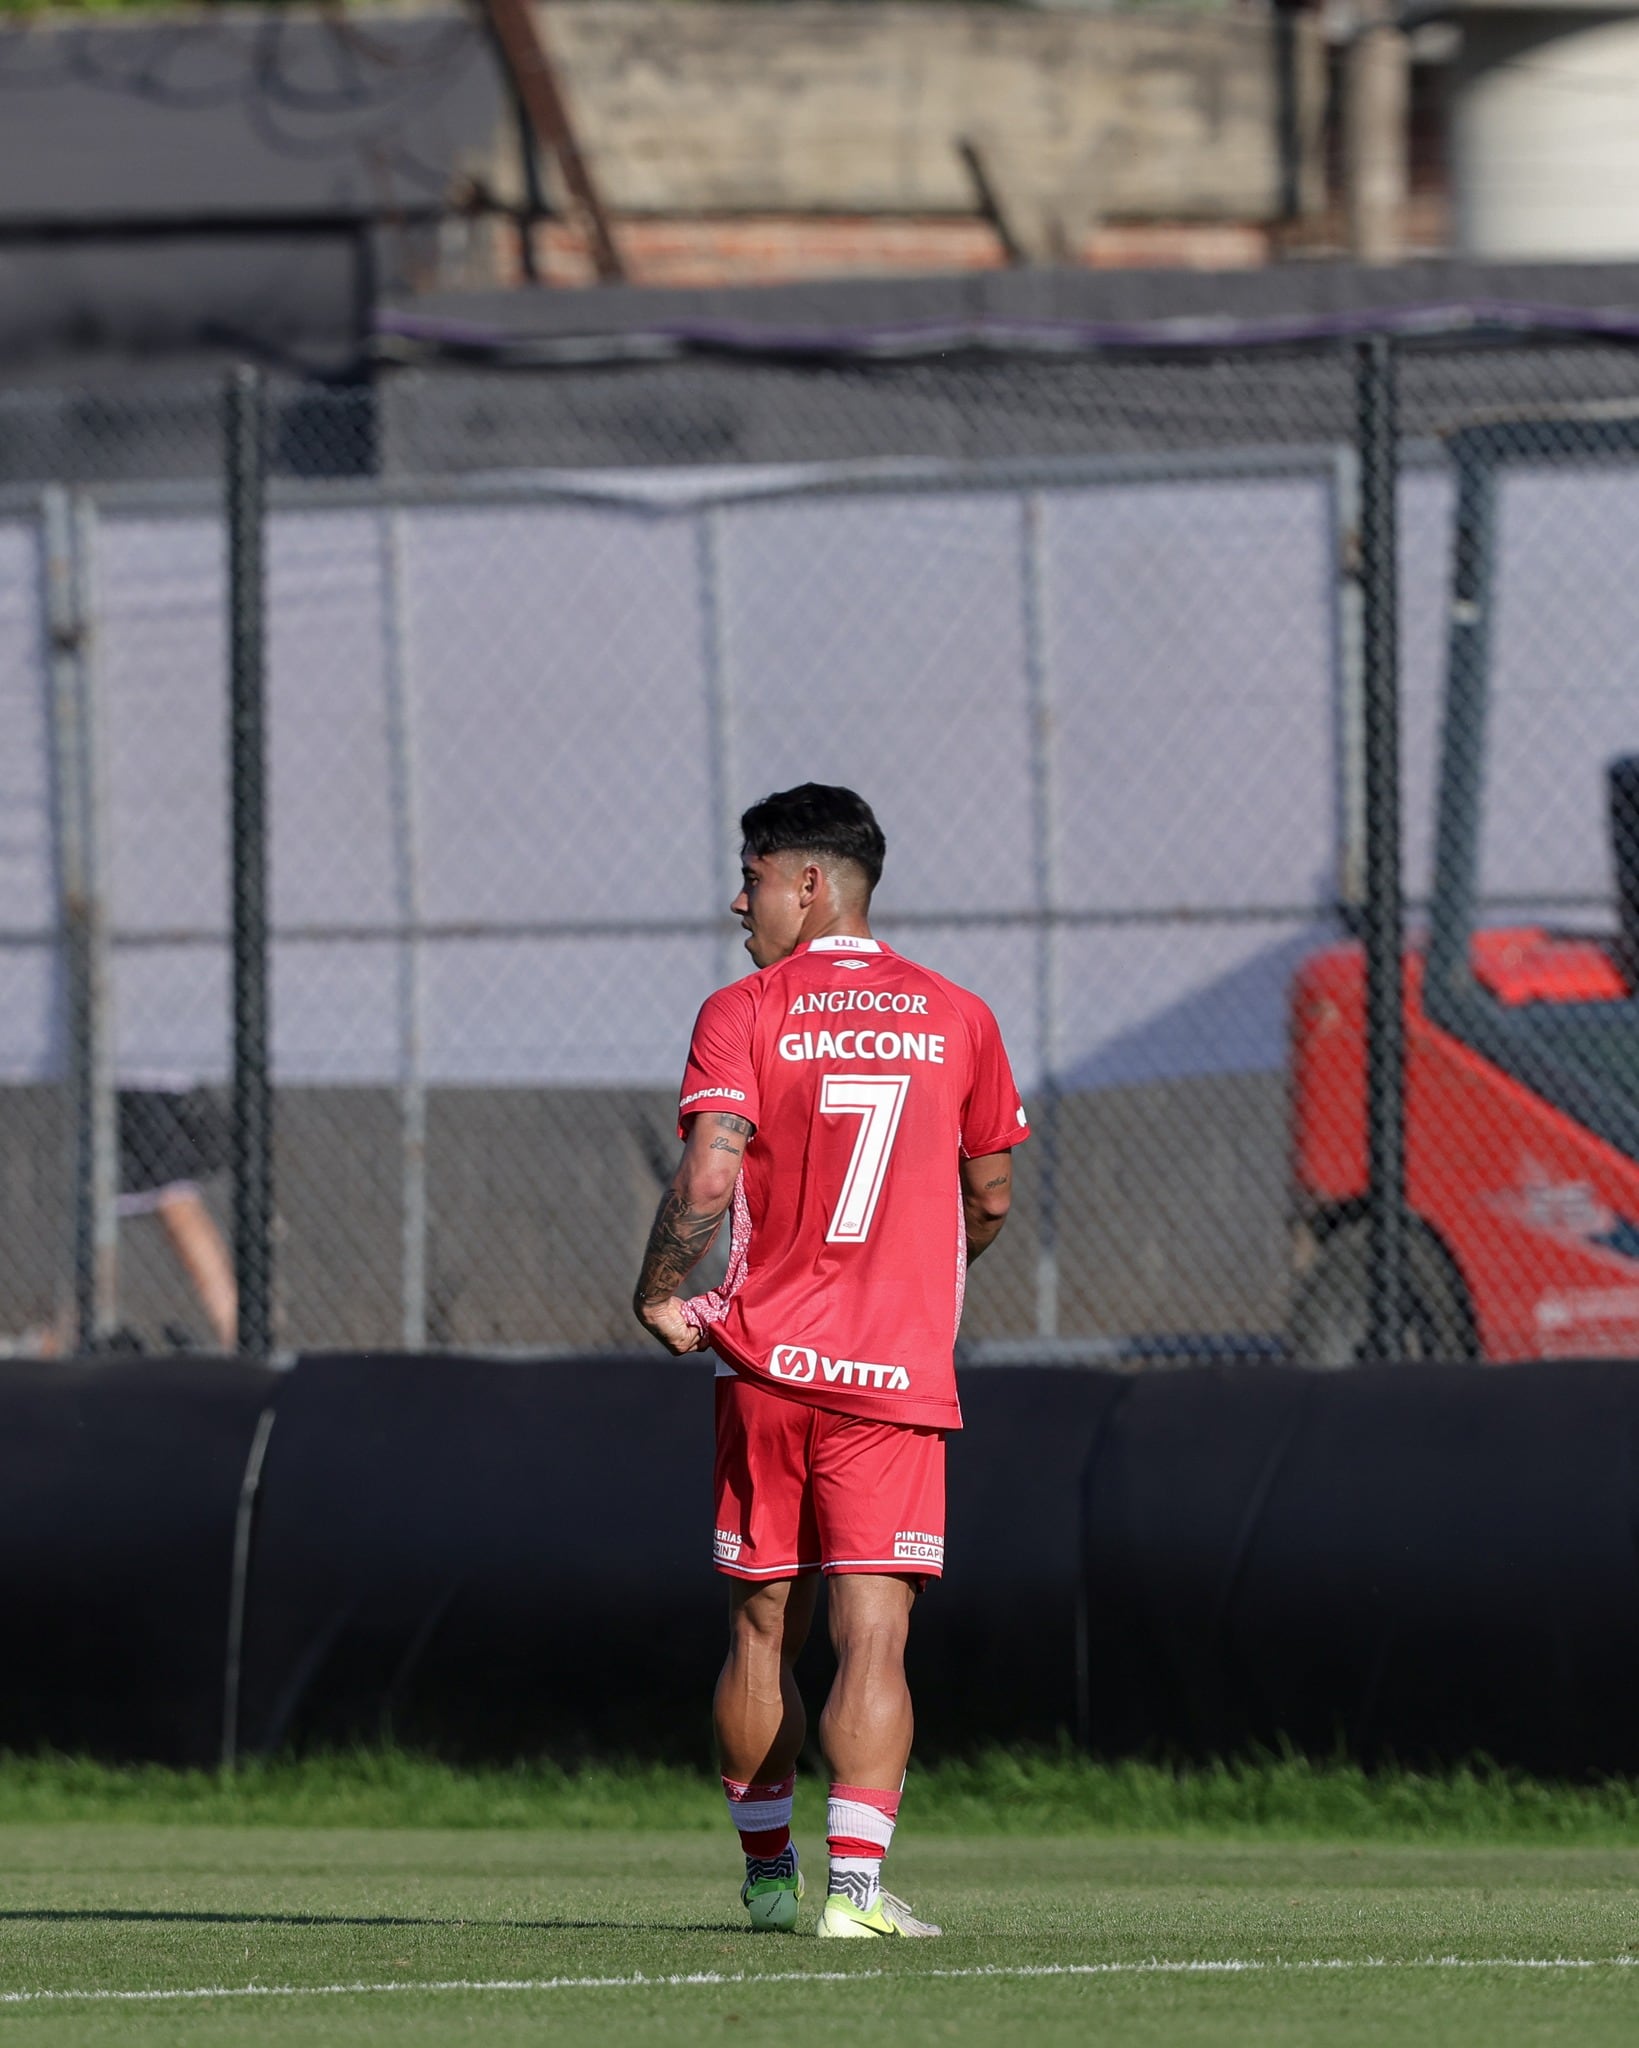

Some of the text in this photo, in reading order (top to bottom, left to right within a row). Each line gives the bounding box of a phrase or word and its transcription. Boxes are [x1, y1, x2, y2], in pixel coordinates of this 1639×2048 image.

[789, 990, 929, 1015] ANGIOCOR
[779, 1030, 945, 1064] GIACCONE
[819, 1074, 911, 1243] 7
[820, 1356, 911, 1390] VITTA
